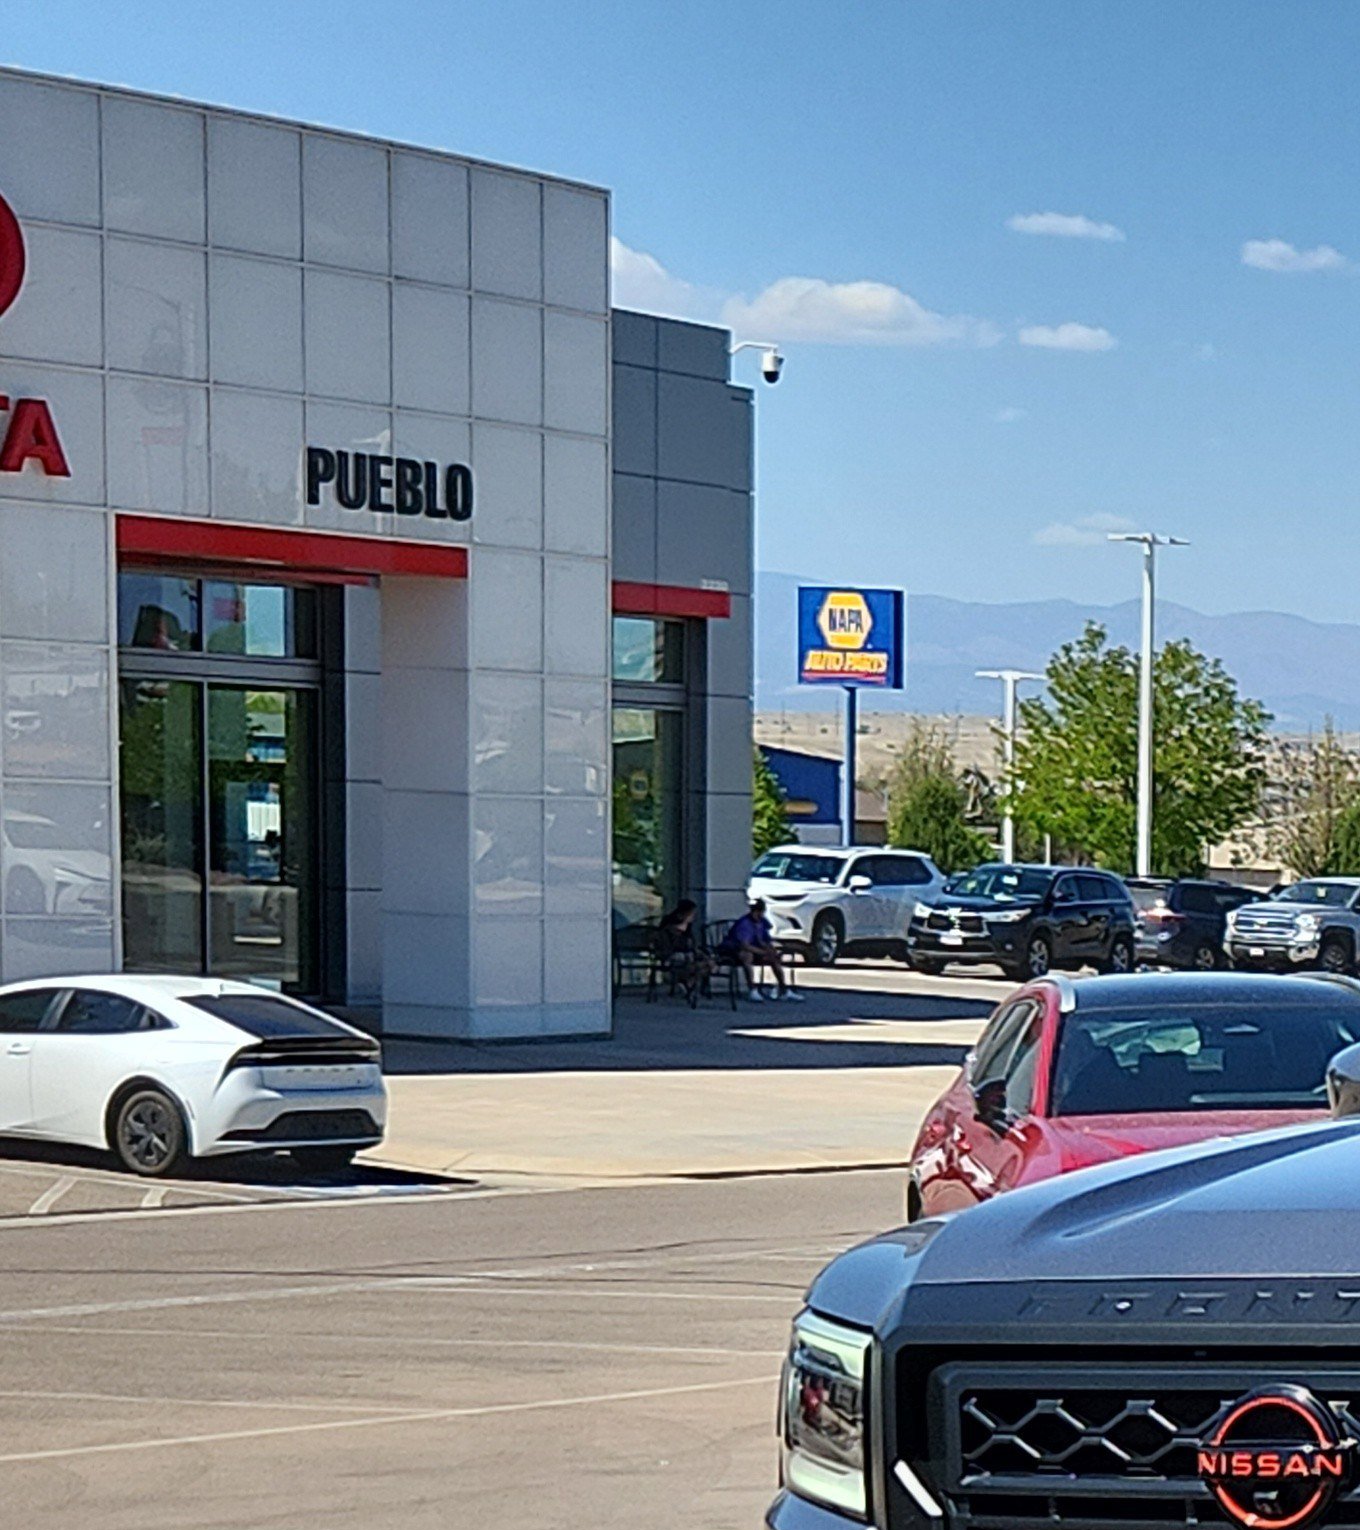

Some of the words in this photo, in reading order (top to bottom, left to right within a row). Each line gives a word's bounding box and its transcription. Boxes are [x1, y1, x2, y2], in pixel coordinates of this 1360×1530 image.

[307, 446, 473, 521] PUEBLO
[828, 608, 864, 633] NAPA
[1198, 1452, 1342, 1477] NISSAN
